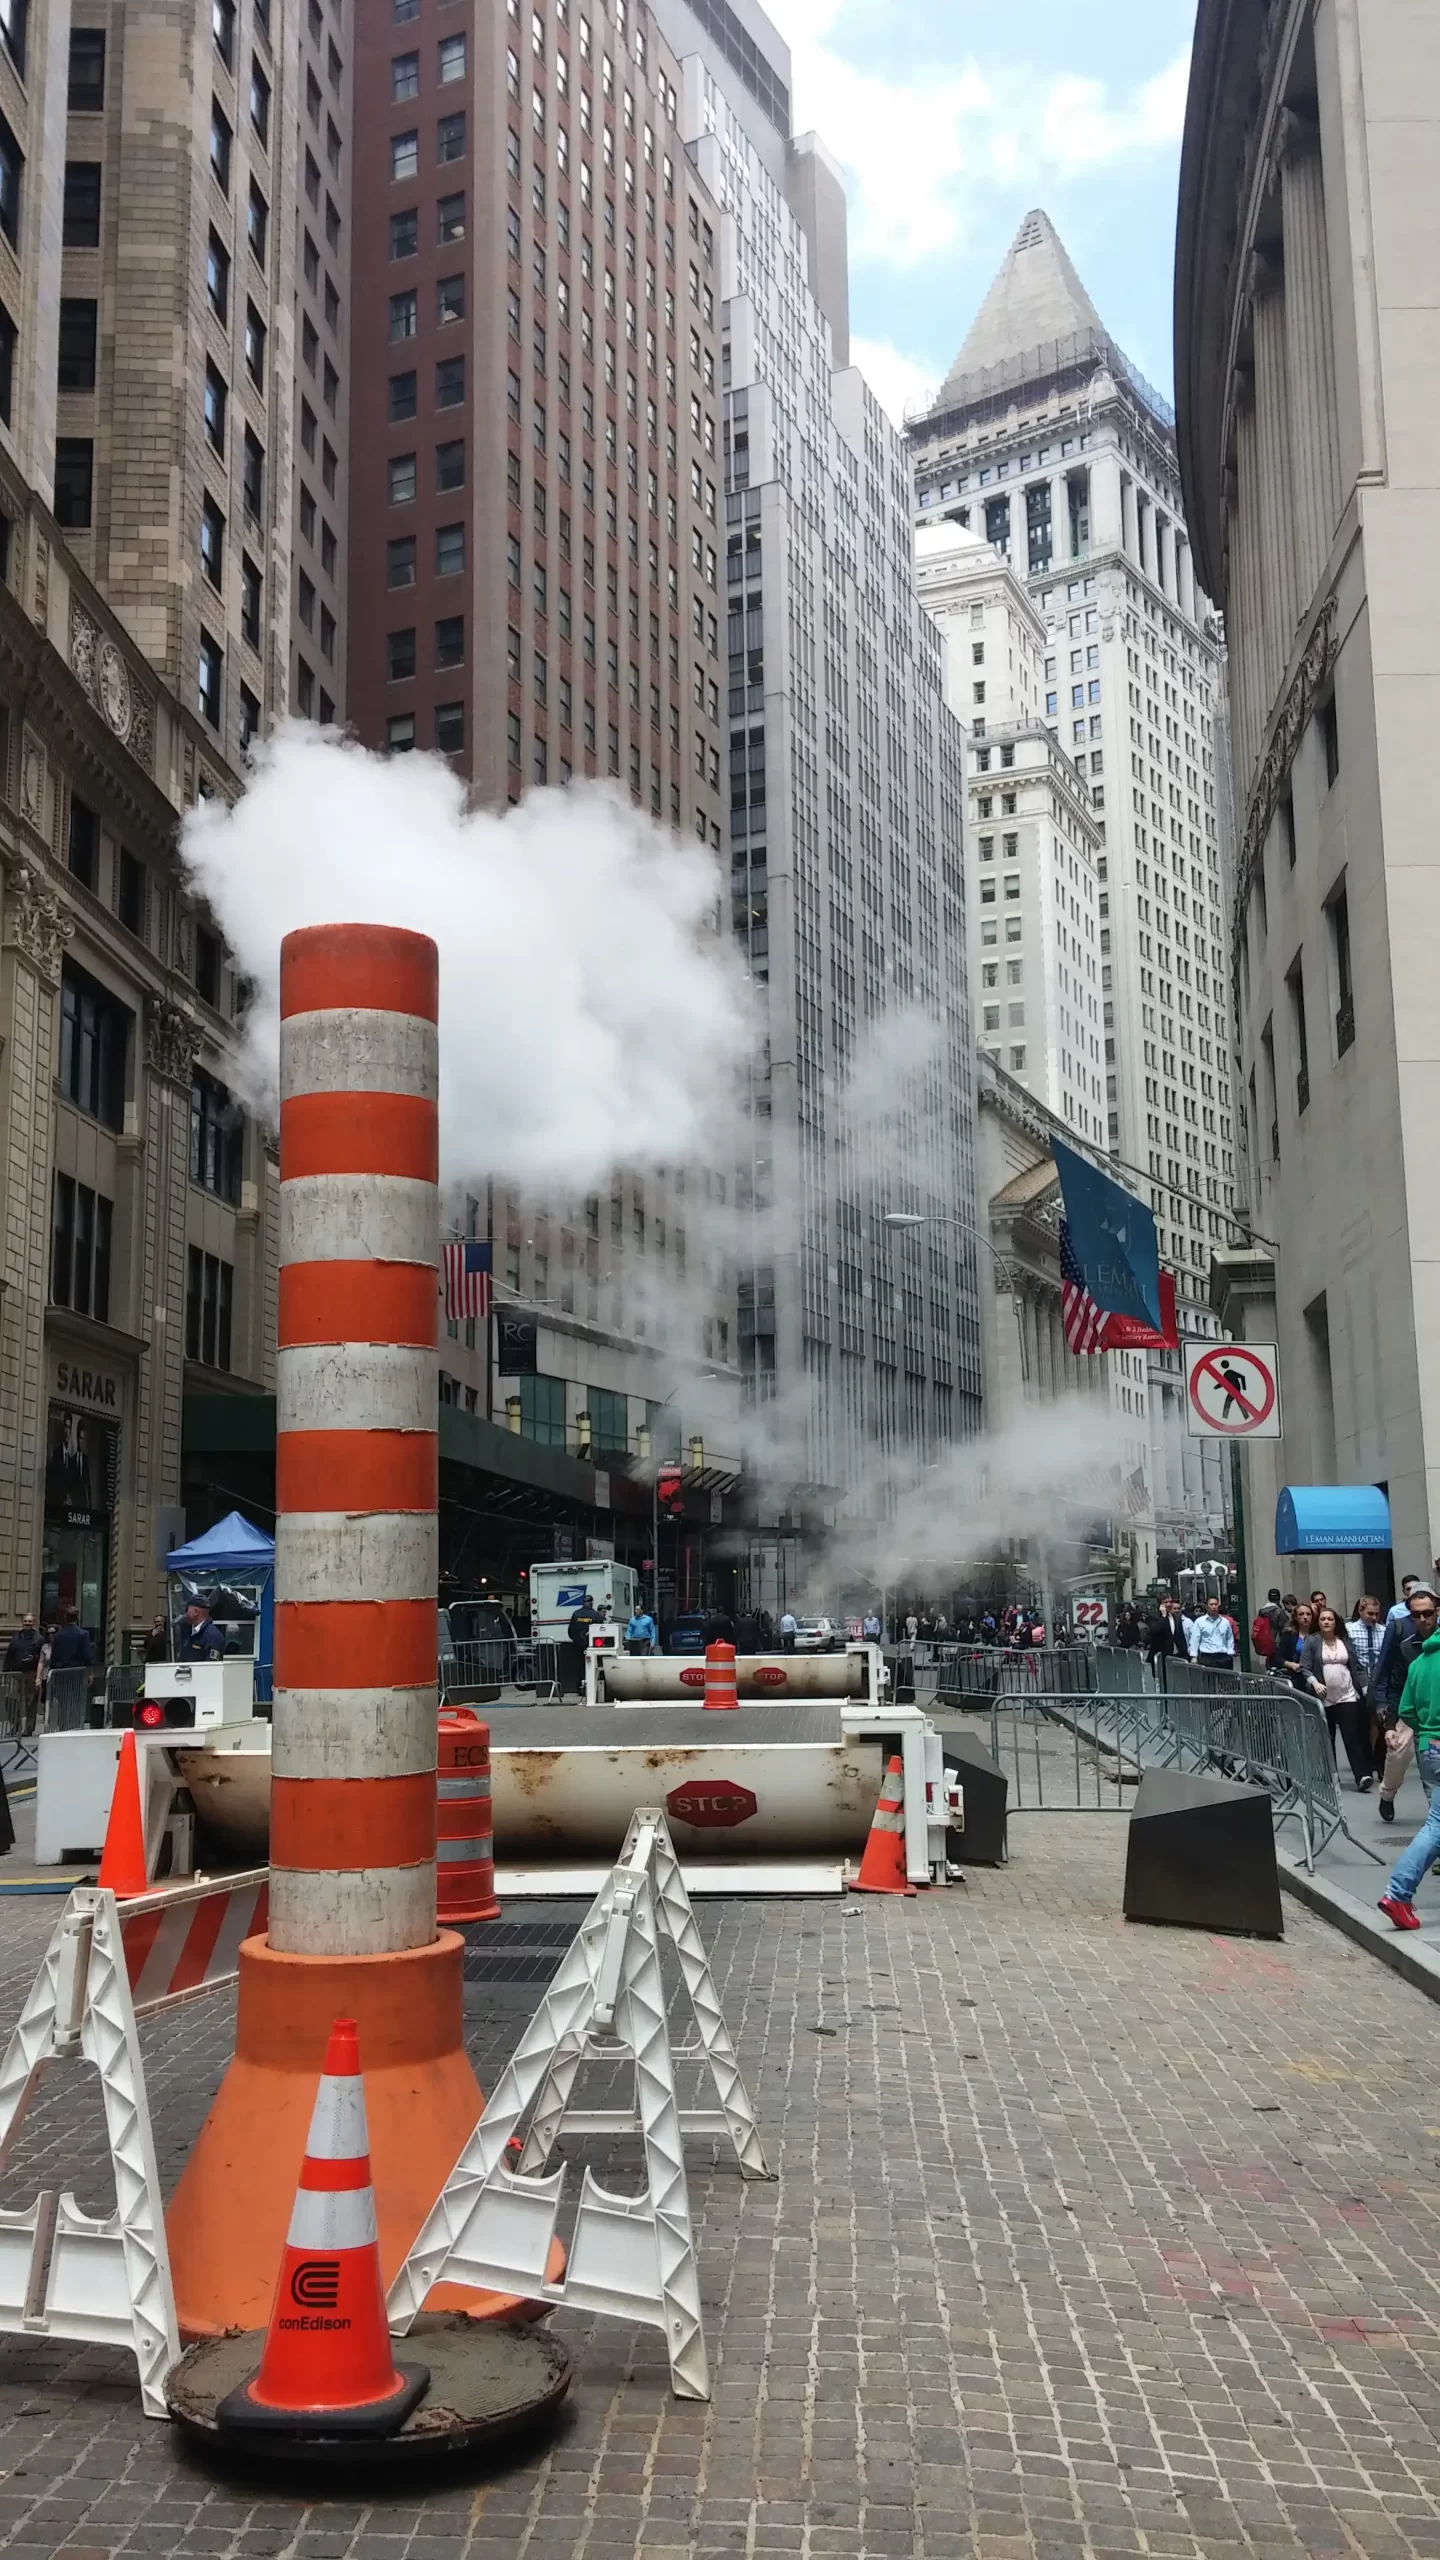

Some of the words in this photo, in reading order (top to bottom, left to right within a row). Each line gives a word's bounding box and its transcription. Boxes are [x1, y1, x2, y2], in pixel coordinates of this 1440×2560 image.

[57, 1361, 116, 1407] SARAR
[67, 1512, 91, 1525] SARAR
[1336, 1534, 1385, 1543] MANHATTAN
[1076, 1602, 1103, 1626] 22
[682, 1673, 706, 1681] STO
[278, 2315, 352, 2331] conEdison
